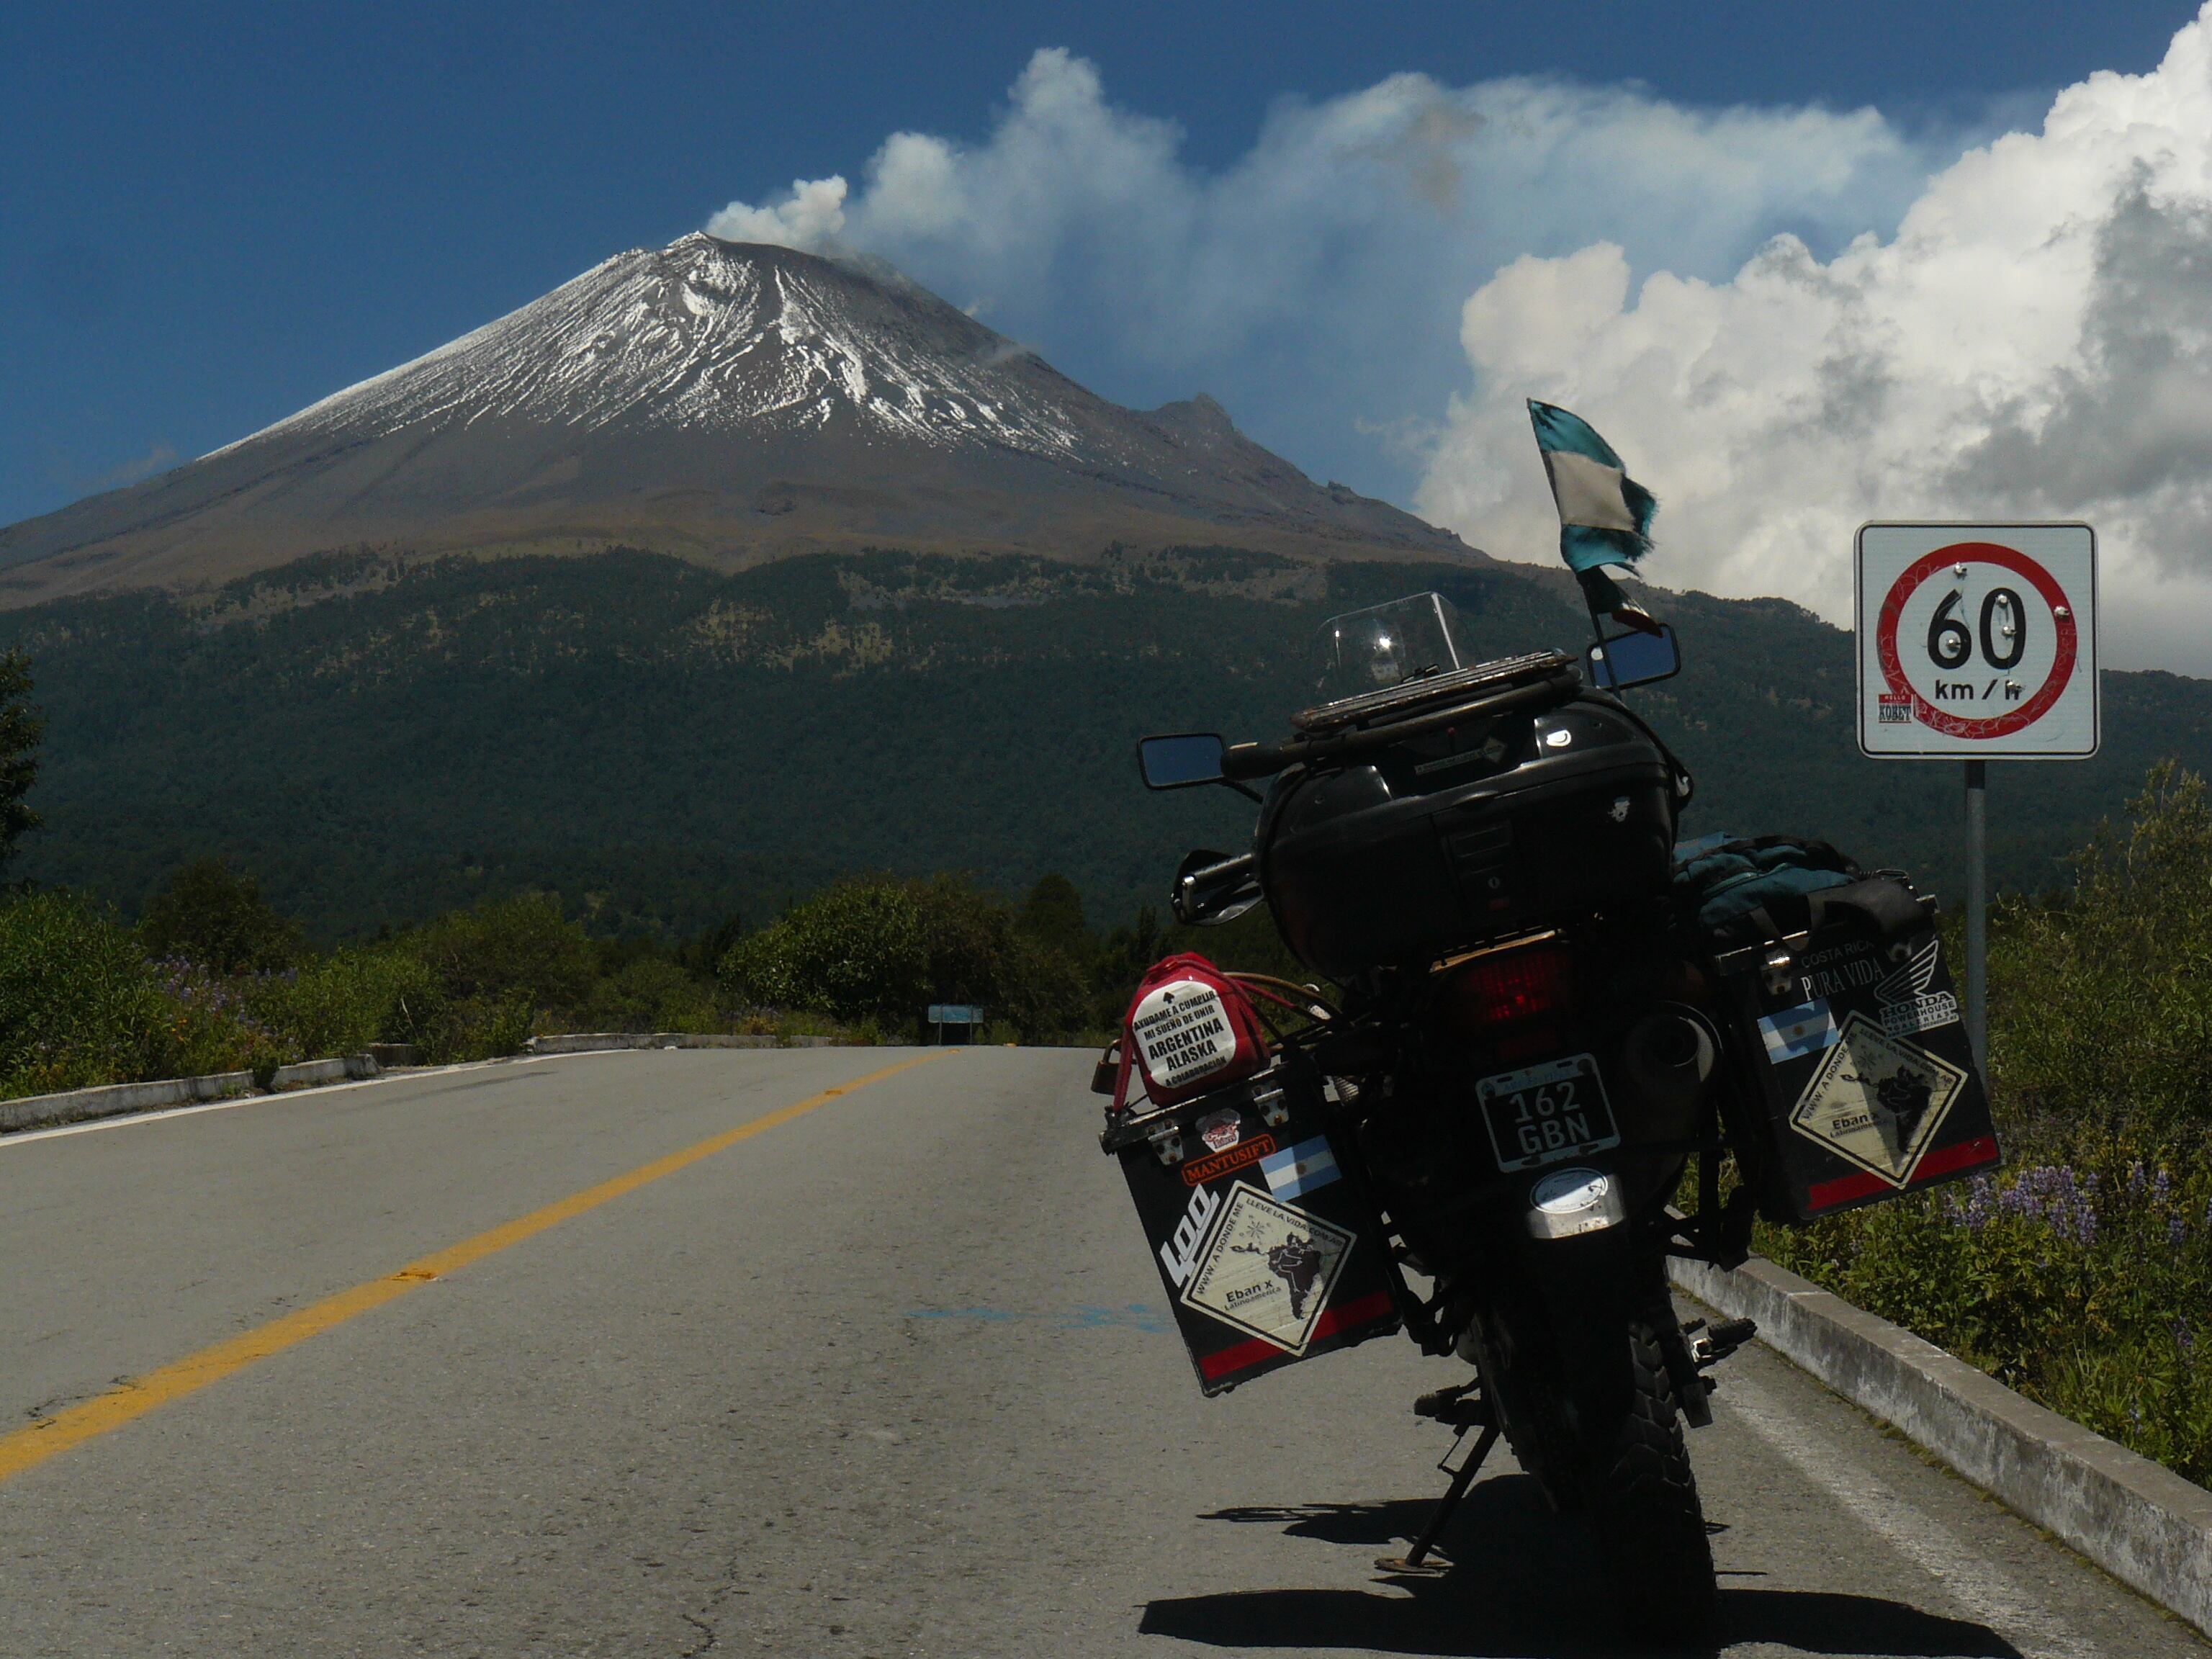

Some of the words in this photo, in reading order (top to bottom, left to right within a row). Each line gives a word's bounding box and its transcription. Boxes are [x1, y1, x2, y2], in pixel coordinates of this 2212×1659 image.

[1928, 588, 2026, 670] 60
[1801, 947, 1843, 968] COSTA
[1799, 967, 1846, 1002] PURA
[1843, 957, 1885, 988] VIDA
[1143, 1029, 1156, 1041] MI
[1157, 1018, 1182, 1035] SUEÑO
[1183, 1014, 1195, 1025] DE
[1195, 1004, 1215, 1020] UNIR
[1173, 1006, 1179, 1015] A
[1883, 994, 1952, 1018] HONDA
[1884, 1001, 1954, 1026] POWERHOUSE
[1148, 1017, 1225, 1061] ARGENTINA
[1165, 1039, 1218, 1071] ALASKA
[1822, 1081, 1830, 1090] A
[1826, 1047, 1849, 1080] DONDE
[1509, 1082, 1581, 1123] 162
[1518, 1112, 1591, 1154] GBN
[1832, 1115, 1868, 1130] Eban
[1246, 1197, 1273, 1215] LLEVE
[1273, 1210, 1285, 1220] LA
[1218, 1218, 1237, 1254] DONDE
[1233, 1202, 1244, 1218] ME
[1226, 1283, 1262, 1303] Eban
